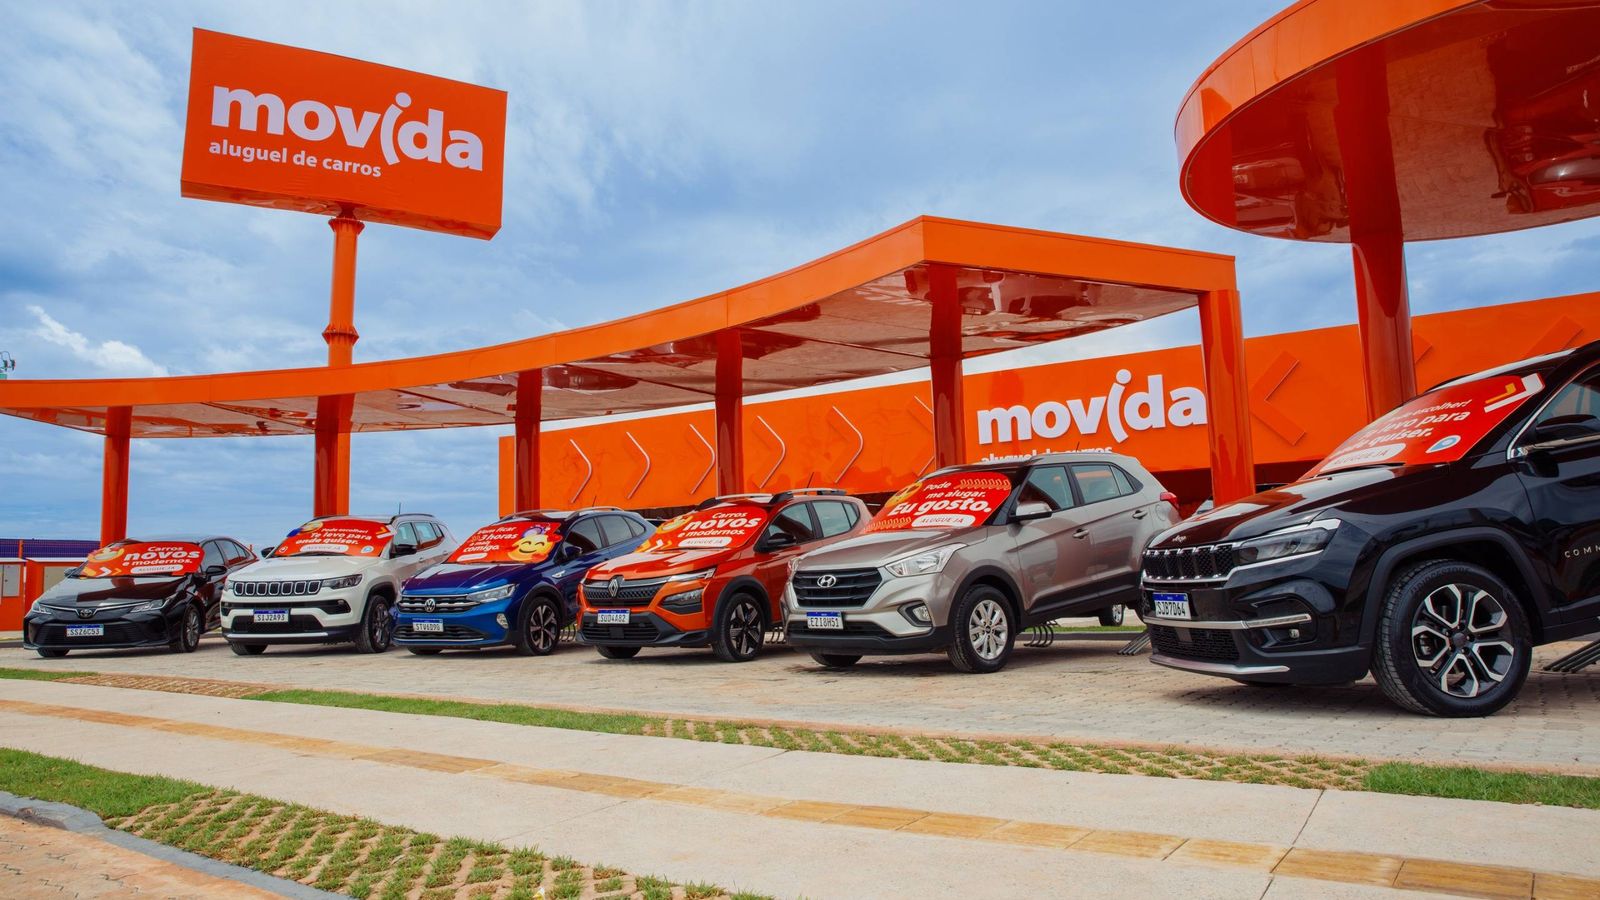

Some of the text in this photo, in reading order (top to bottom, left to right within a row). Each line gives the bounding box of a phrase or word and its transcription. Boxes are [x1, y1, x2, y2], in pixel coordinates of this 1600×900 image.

[211, 85, 483, 171] movida
[208, 138, 382, 177] aluguel de carros
[976, 368, 1208, 445] movida
[1415, 411, 1471, 428] para
[923, 481, 952, 491] Pode
[925, 489, 986, 500] me alugar.
[887, 497, 992, 516] Eu gosto.
[682, 517, 762, 531] novos
[347, 532, 372, 541] para
[486, 533, 519, 541] horas
[124, 550, 201, 561] novos
